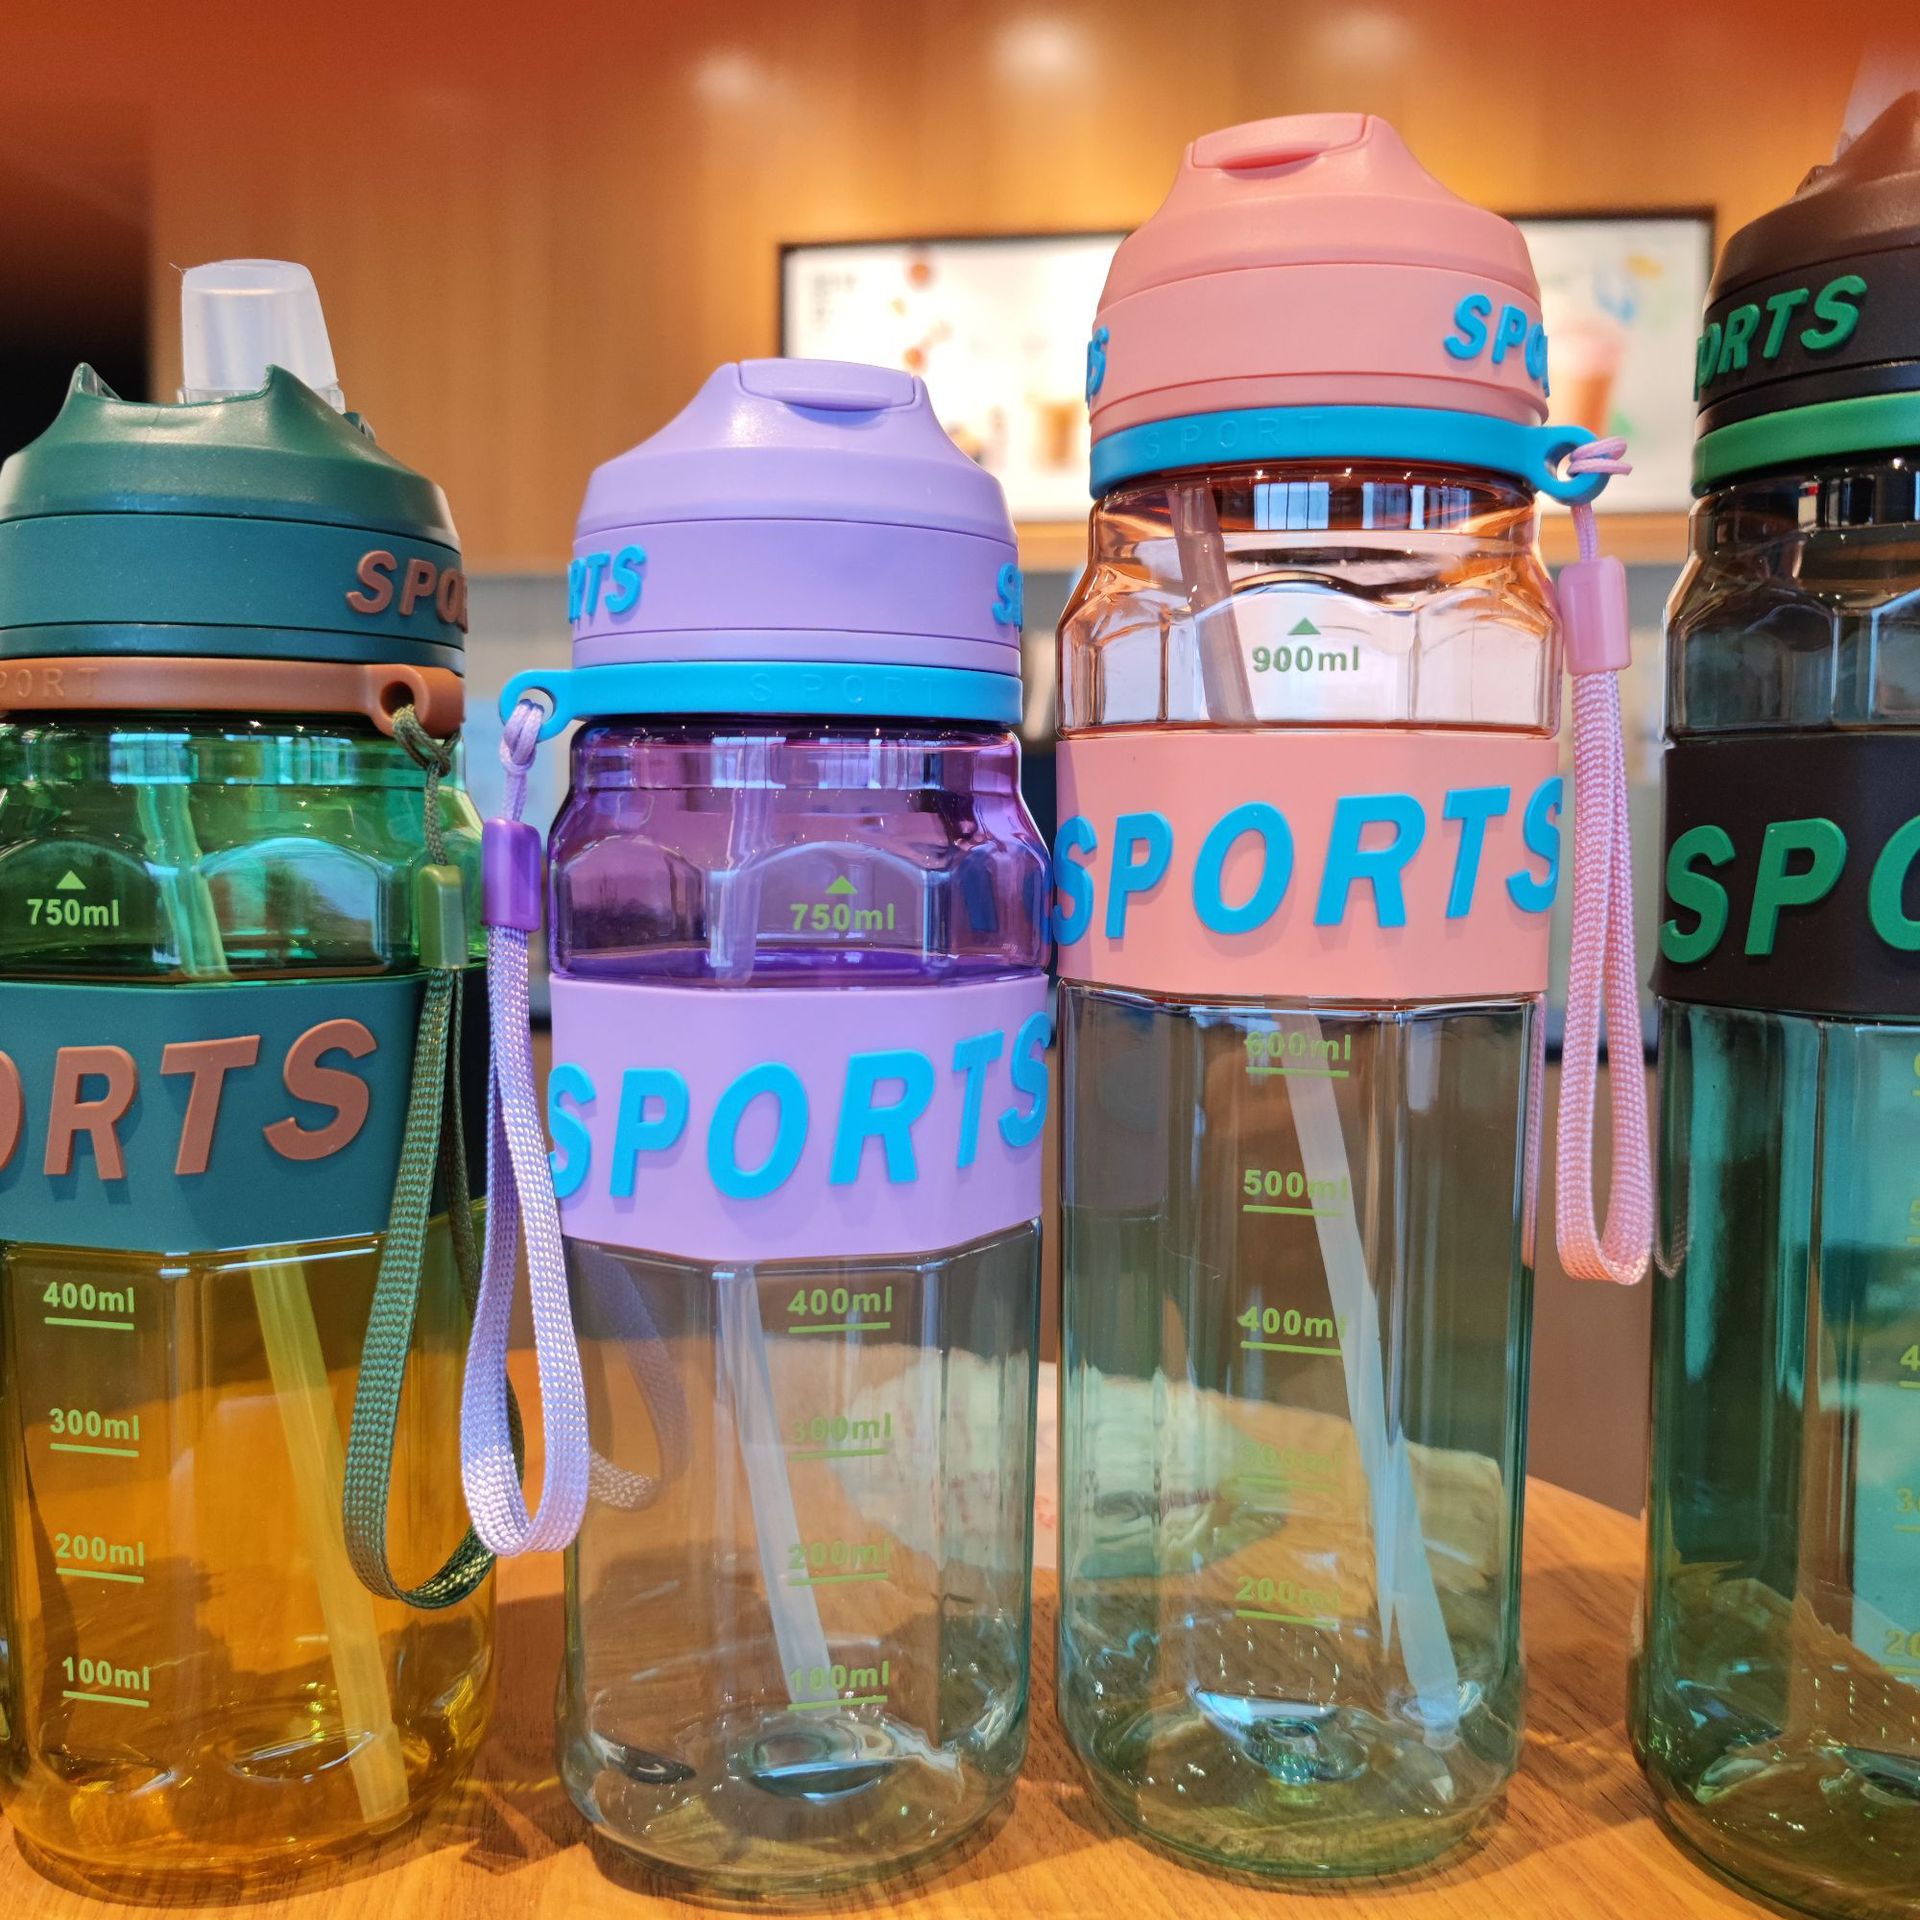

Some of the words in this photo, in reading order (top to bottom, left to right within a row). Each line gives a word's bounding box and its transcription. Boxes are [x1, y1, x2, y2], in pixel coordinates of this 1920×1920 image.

[1443, 293, 1550, 399] SPO
[1693, 274, 1868, 402] ORTS
[1144, 414, 1323, 461] SPORT
[345, 549, 468, 634] SPO
[1251, 645, 1360, 673] 900ml
[1052, 776, 1564, 946] SPORTS
[27, 898, 120, 927] 750ml
[789, 903, 896, 931] 750ml
[1243, 1031, 1351, 1060] 600ml
[547, 1010, 1053, 1199] SPORTS
[1243, 1169, 1348, 1199] 500ml
[42, 1281, 135, 1313] 400ml
[787, 1285, 893, 1316] 400ml
[49, 1407, 140, 1441] 300ml
[789, 1411, 893, 1445] 300ml
[55, 1532, 145, 1567] 200ml
[788, 1536, 891, 1570] 200ml
[62, 1656, 150, 1691] 100ml
[789, 1660, 890, 1692] 100ml
